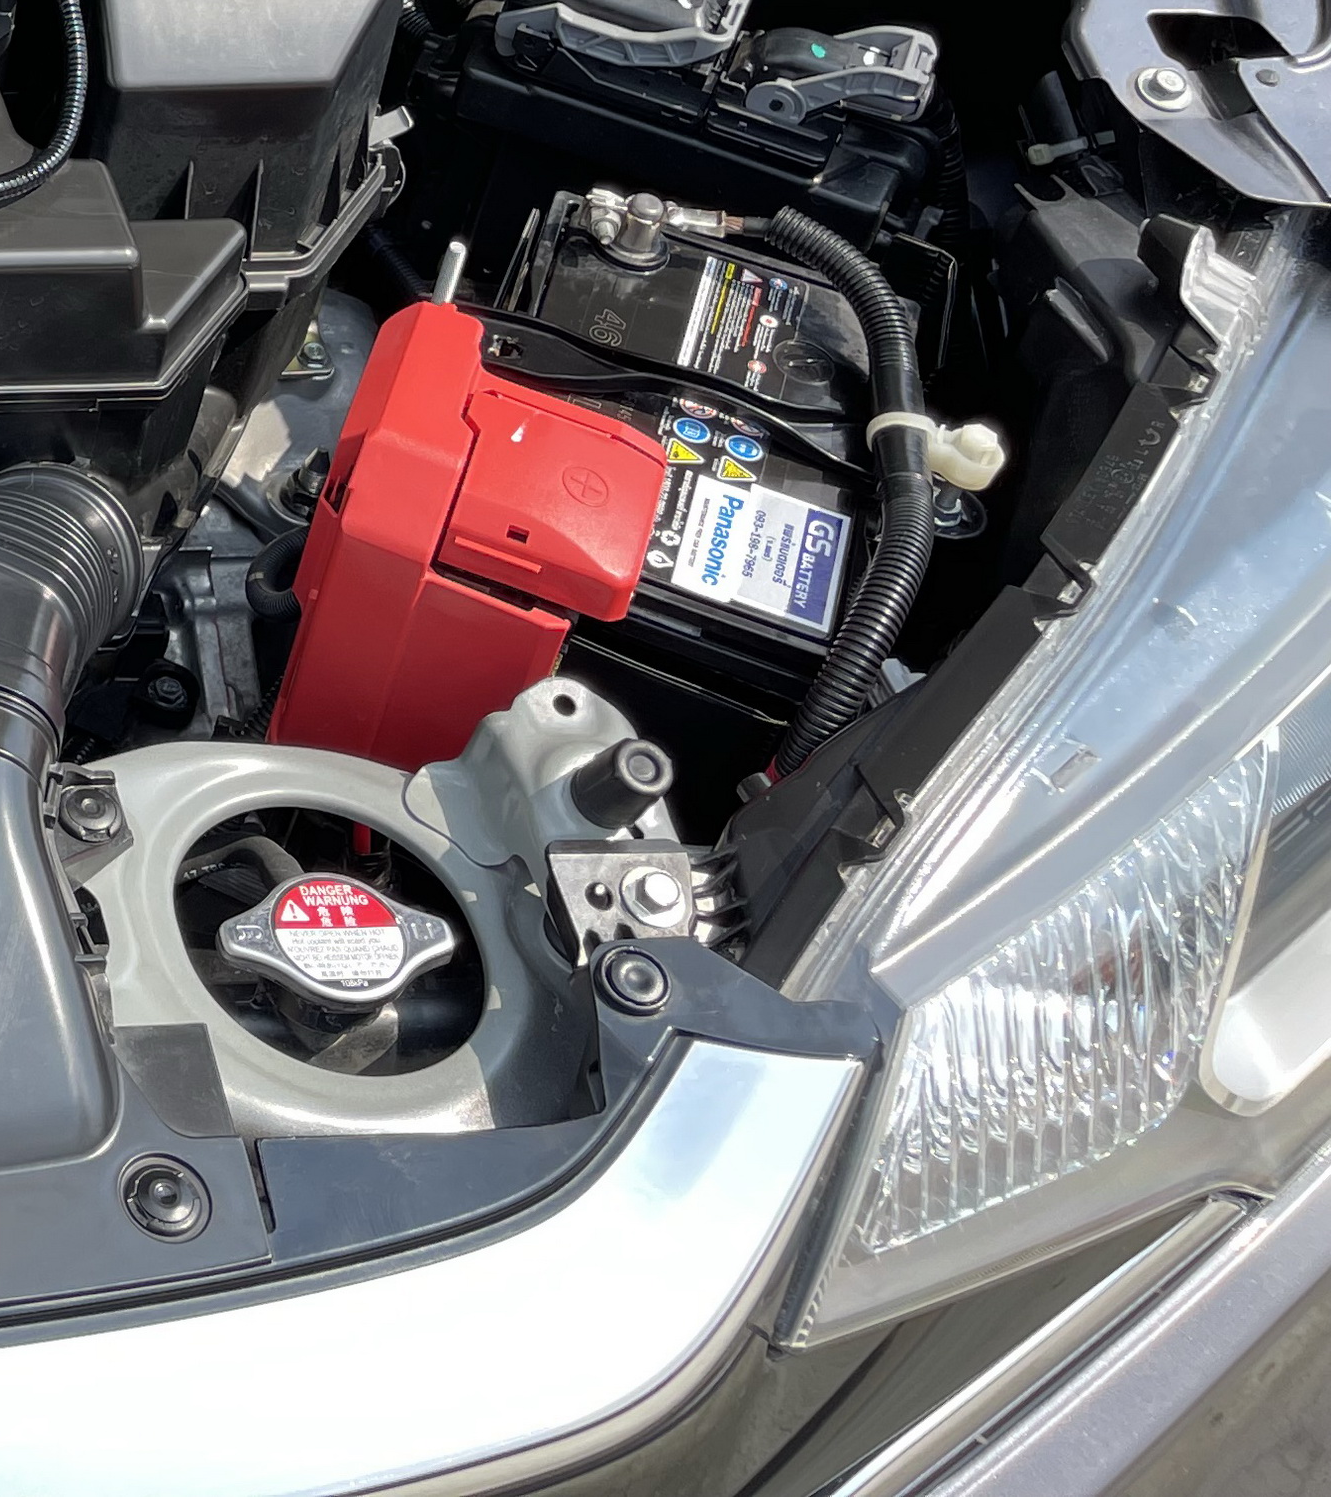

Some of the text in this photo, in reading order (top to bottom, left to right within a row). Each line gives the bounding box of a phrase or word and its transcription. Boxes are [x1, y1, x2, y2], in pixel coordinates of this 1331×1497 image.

[589, 308, 626, 346] 46
[701, 494, 745, 587] Panasonic
[793, 519, 837, 609] GS BATTERY
[299, 885, 353, 896] DANGER
[303, 894, 370, 906] WARNUNG
